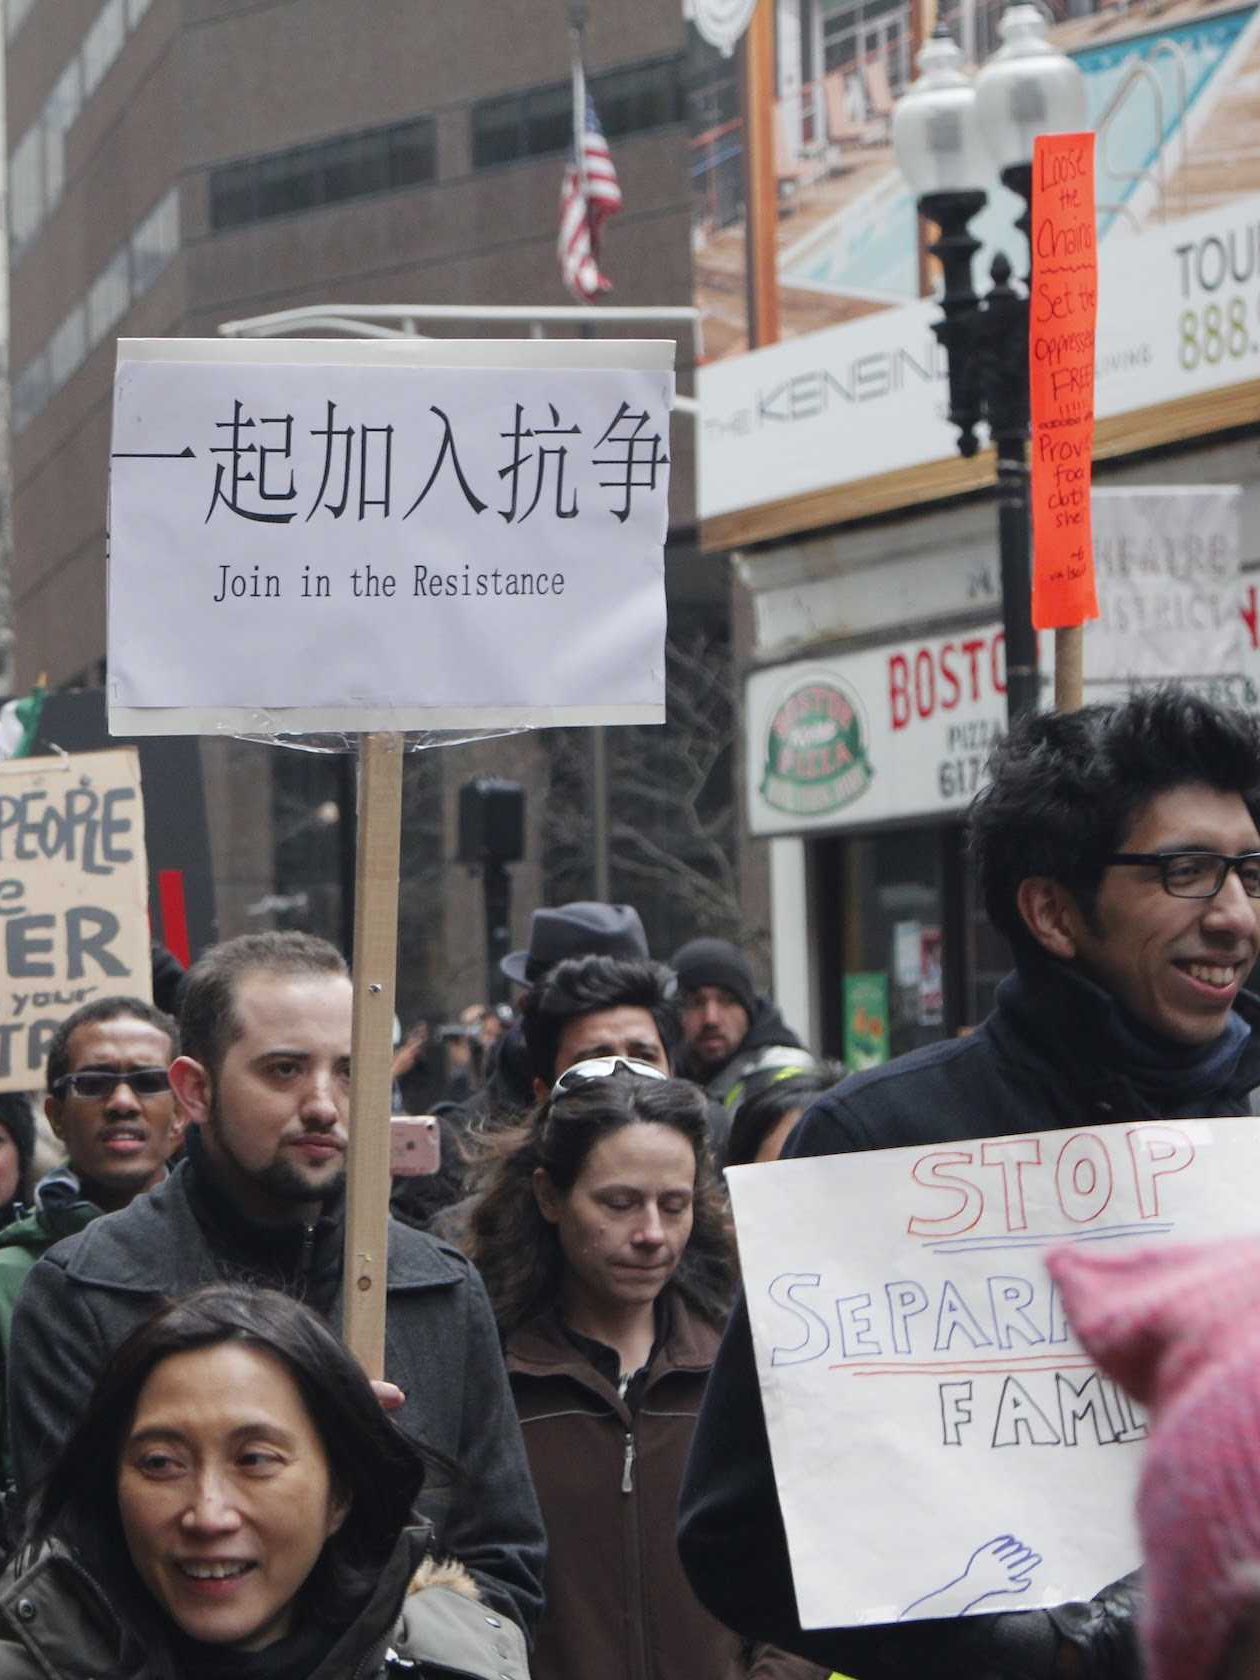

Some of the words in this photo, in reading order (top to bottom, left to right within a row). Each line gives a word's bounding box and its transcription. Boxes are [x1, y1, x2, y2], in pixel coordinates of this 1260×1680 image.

[1040, 148, 1086, 192] Loose
[1059, 187, 1082, 211] the
[1174, 222, 1260, 299] TOU
[1036, 283, 1074, 322] Set
[757, 338, 948, 429] KENSIN
[111, 400, 670, 525] 一起加入抗争
[1039, 432, 1090, 463] Prov
[213, 565, 281, 603] Join
[301, 568, 331, 598] in
[351, 565, 396, 598] the
[413, 564, 566, 598] Resistance
[888, 632, 1009, 733] BOSTO
[10, 986, 100, 1010] your
[907, 1126, 1196, 1238] STOP
